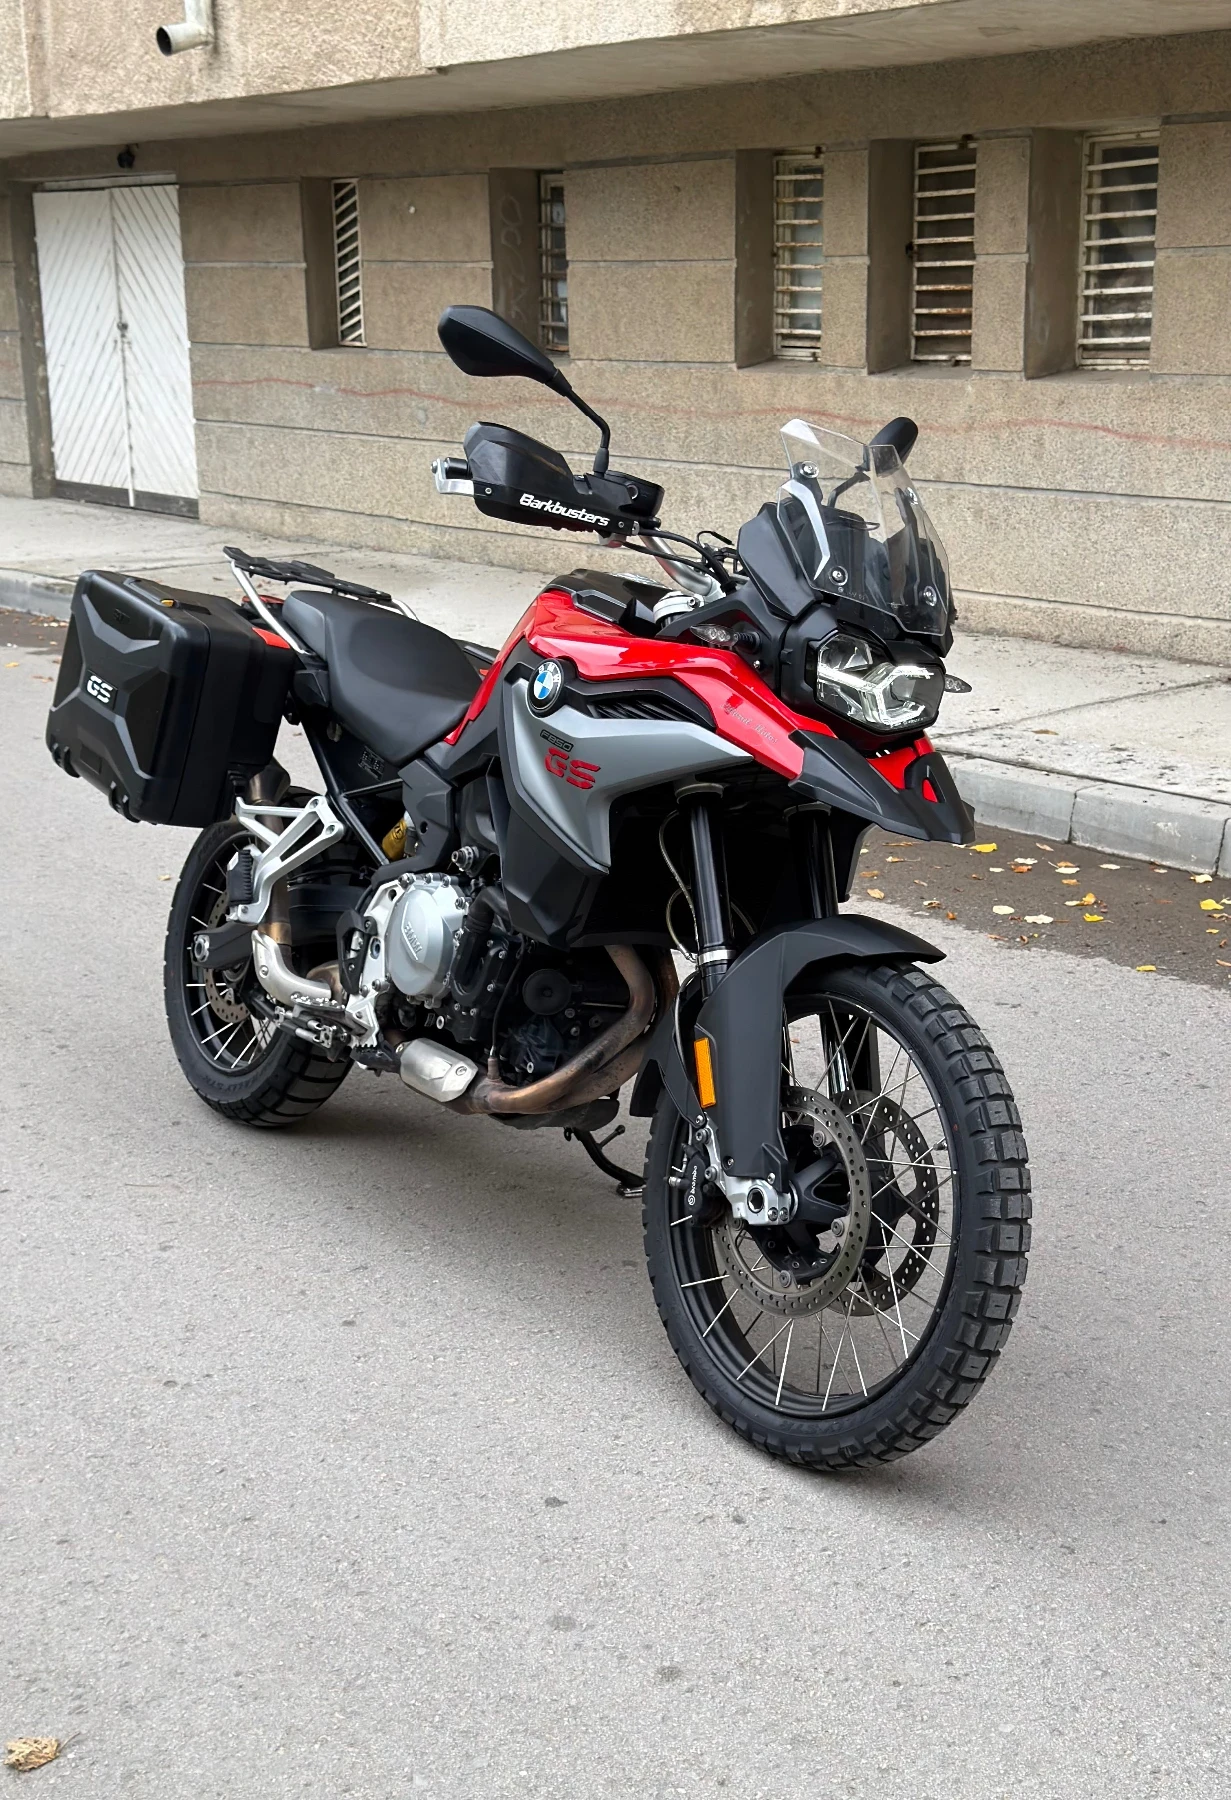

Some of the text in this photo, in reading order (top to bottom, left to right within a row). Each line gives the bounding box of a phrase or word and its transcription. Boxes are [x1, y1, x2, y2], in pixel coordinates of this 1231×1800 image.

[519, 492, 610, 527] Barkbusters
[538, 662, 562, 683] BMW
[87, 675, 113, 703] GS
[544, 747, 601, 790] GS
[689, 1165, 698, 1195] brembo
